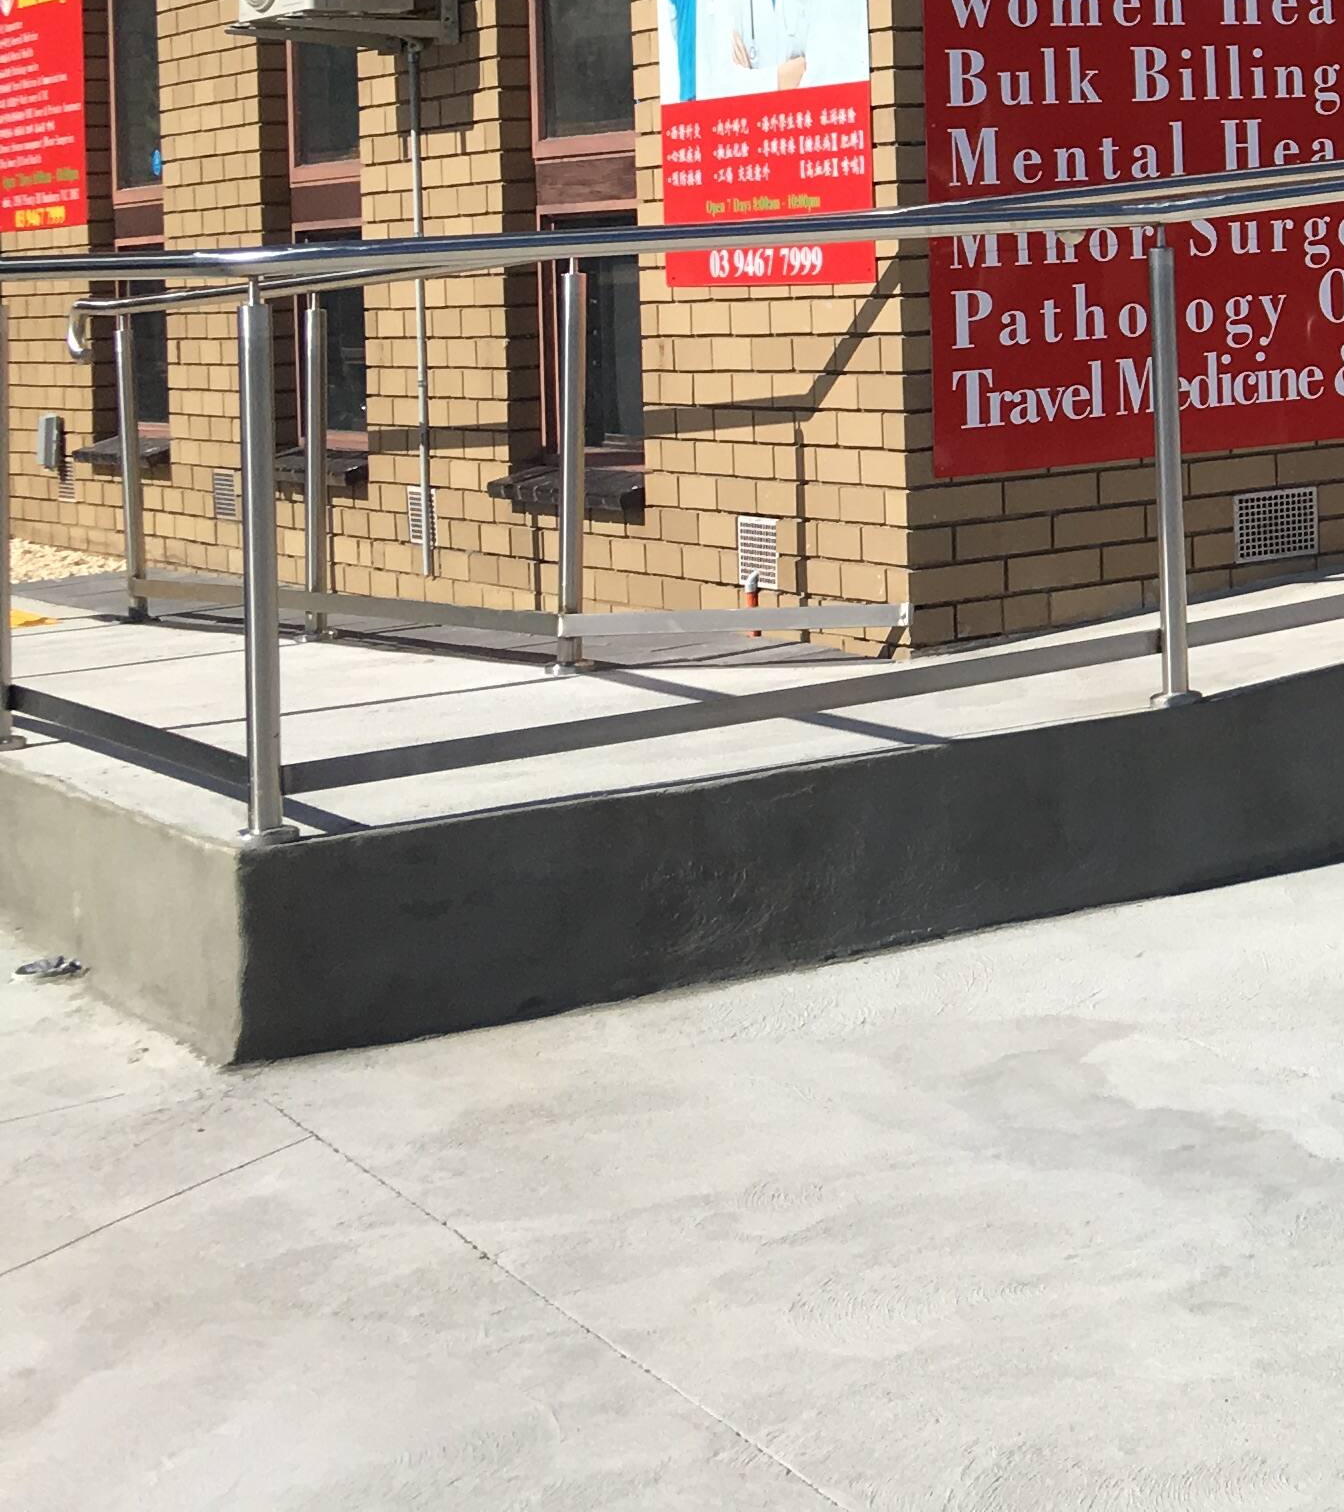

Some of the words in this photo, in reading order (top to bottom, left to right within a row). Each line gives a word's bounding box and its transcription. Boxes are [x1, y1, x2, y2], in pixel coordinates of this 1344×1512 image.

[945, 46, 1103, 107] Bulk
[1130, 44, 1342, 116] Billing
[947, 121, 1187, 187] Mental
[709, 249, 731, 278] 03
[733, 247, 774, 278] 9467
[780, 246, 823, 276] 7999
[950, 284, 1286, 350] Pathoogy
[952, 360, 1106, 430] Travel
[1115, 351, 1324, 417] Medicine
